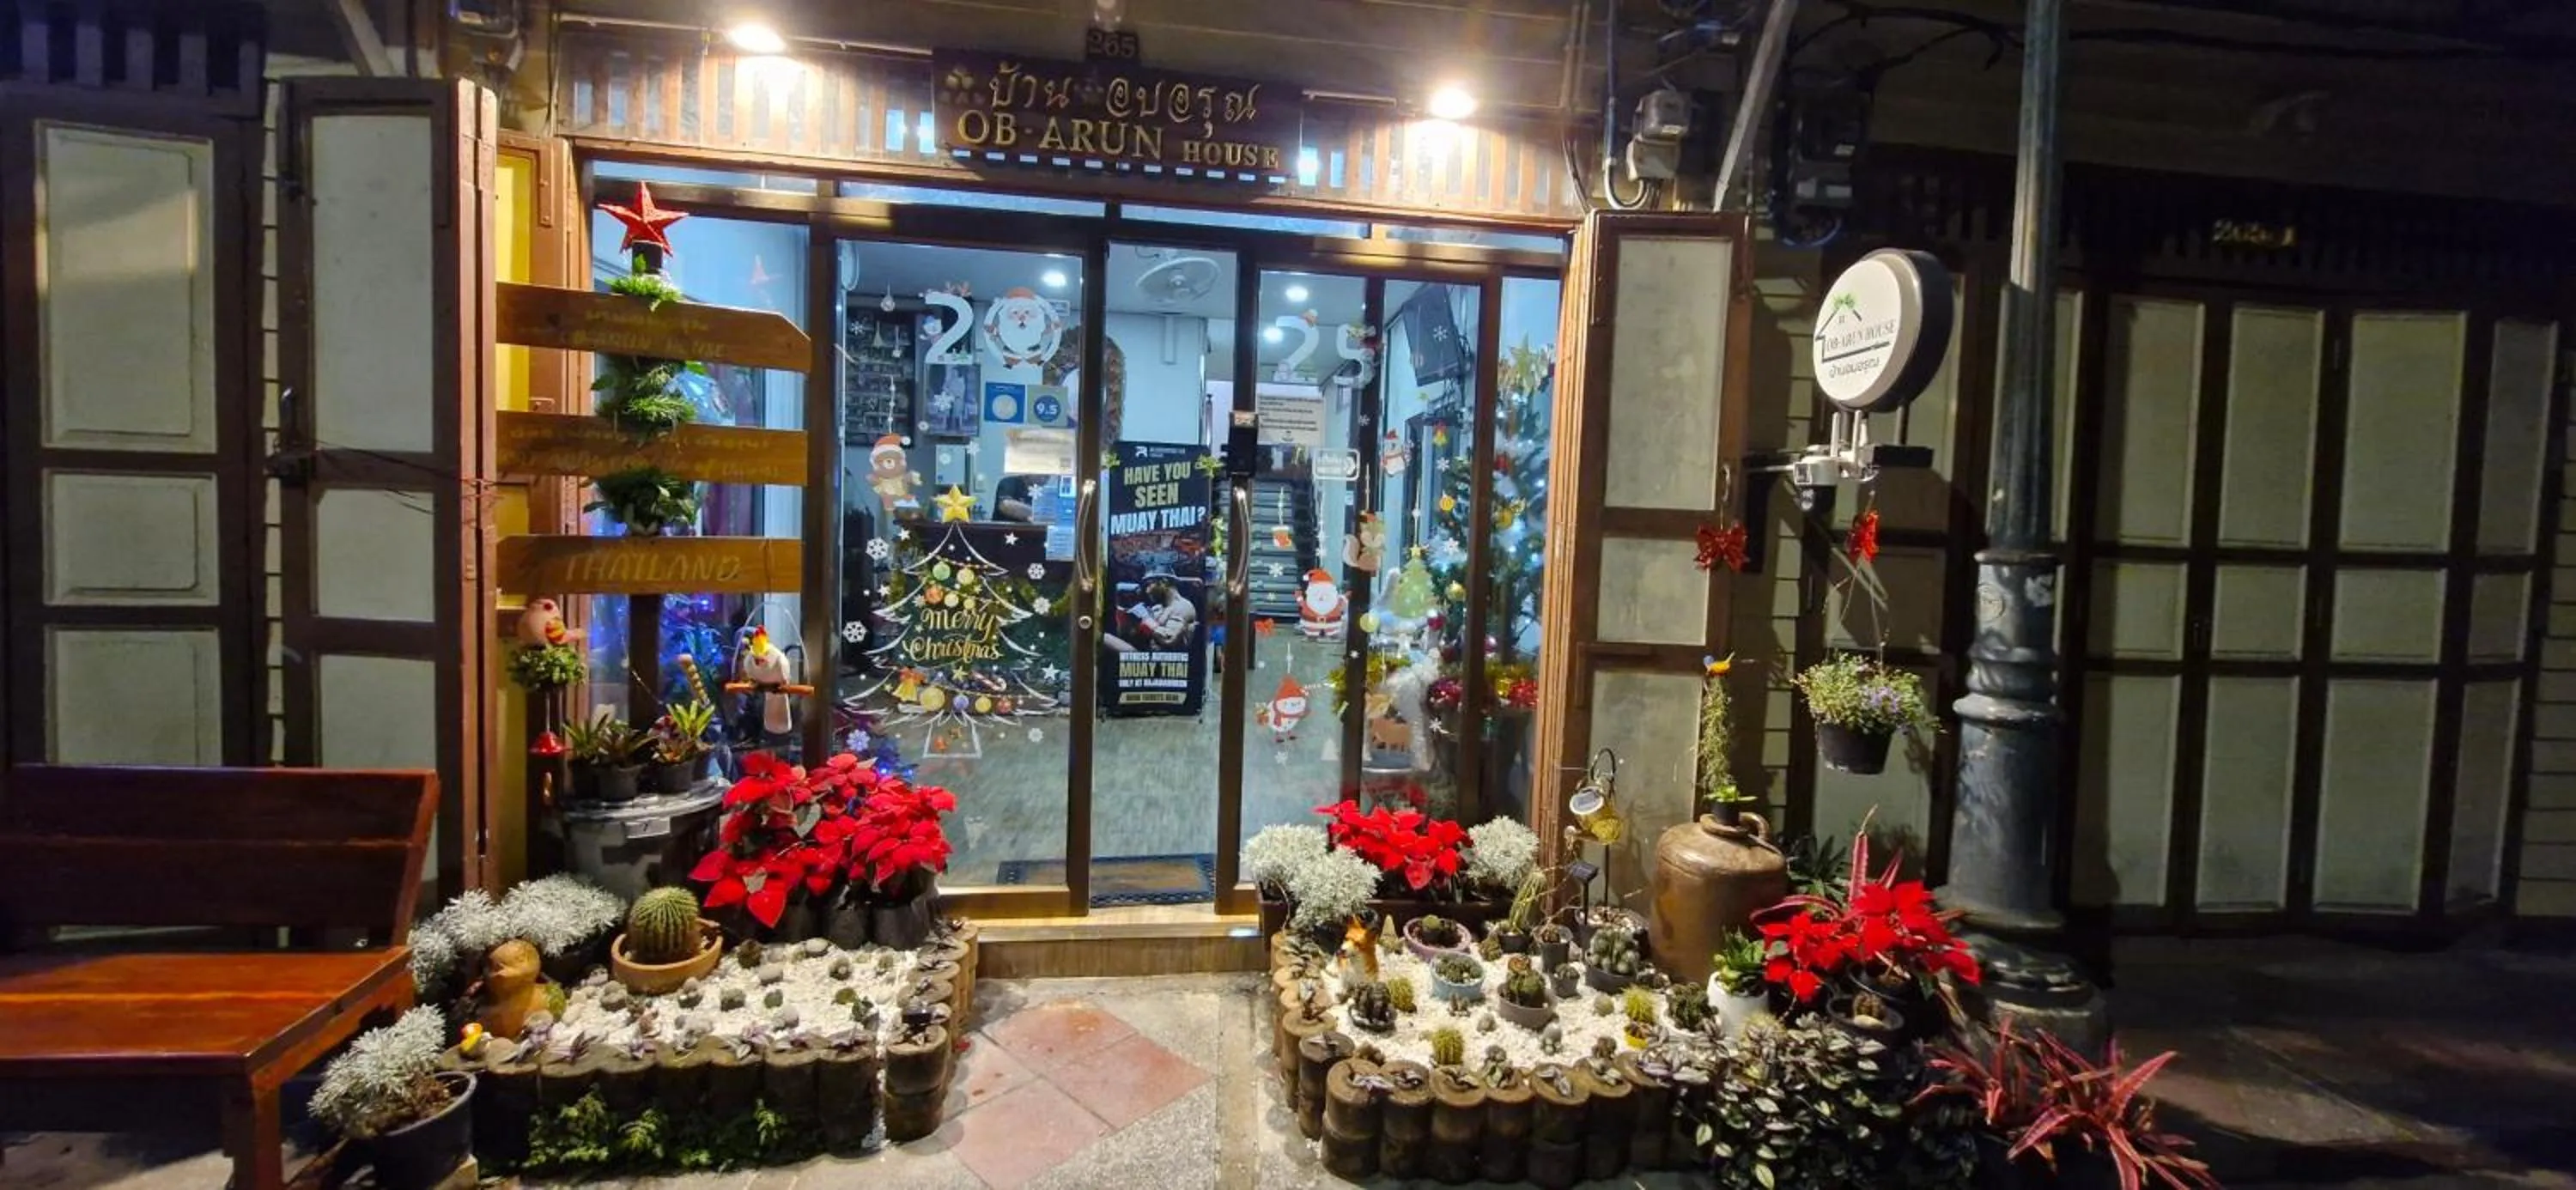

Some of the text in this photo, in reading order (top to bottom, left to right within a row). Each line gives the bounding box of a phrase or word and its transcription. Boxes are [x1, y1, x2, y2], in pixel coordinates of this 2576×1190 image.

[1086, 31, 1135, 58] 265
[988, 62, 1261, 139] บ้าน อบอรุณ
[1182, 139, 1279, 169] HOUSE
[1124, 461, 1191, 485] HAVE YOU
[1135, 483, 1179, 508] SEEN
[1111, 506, 1206, 535] MUAY THAI?
[566, 552, 742, 582] THAILAND
[920, 607, 995, 643] Merry
[903, 634, 1004, 663] Christmas
[1119, 662, 1188, 677] MUAY THAI
